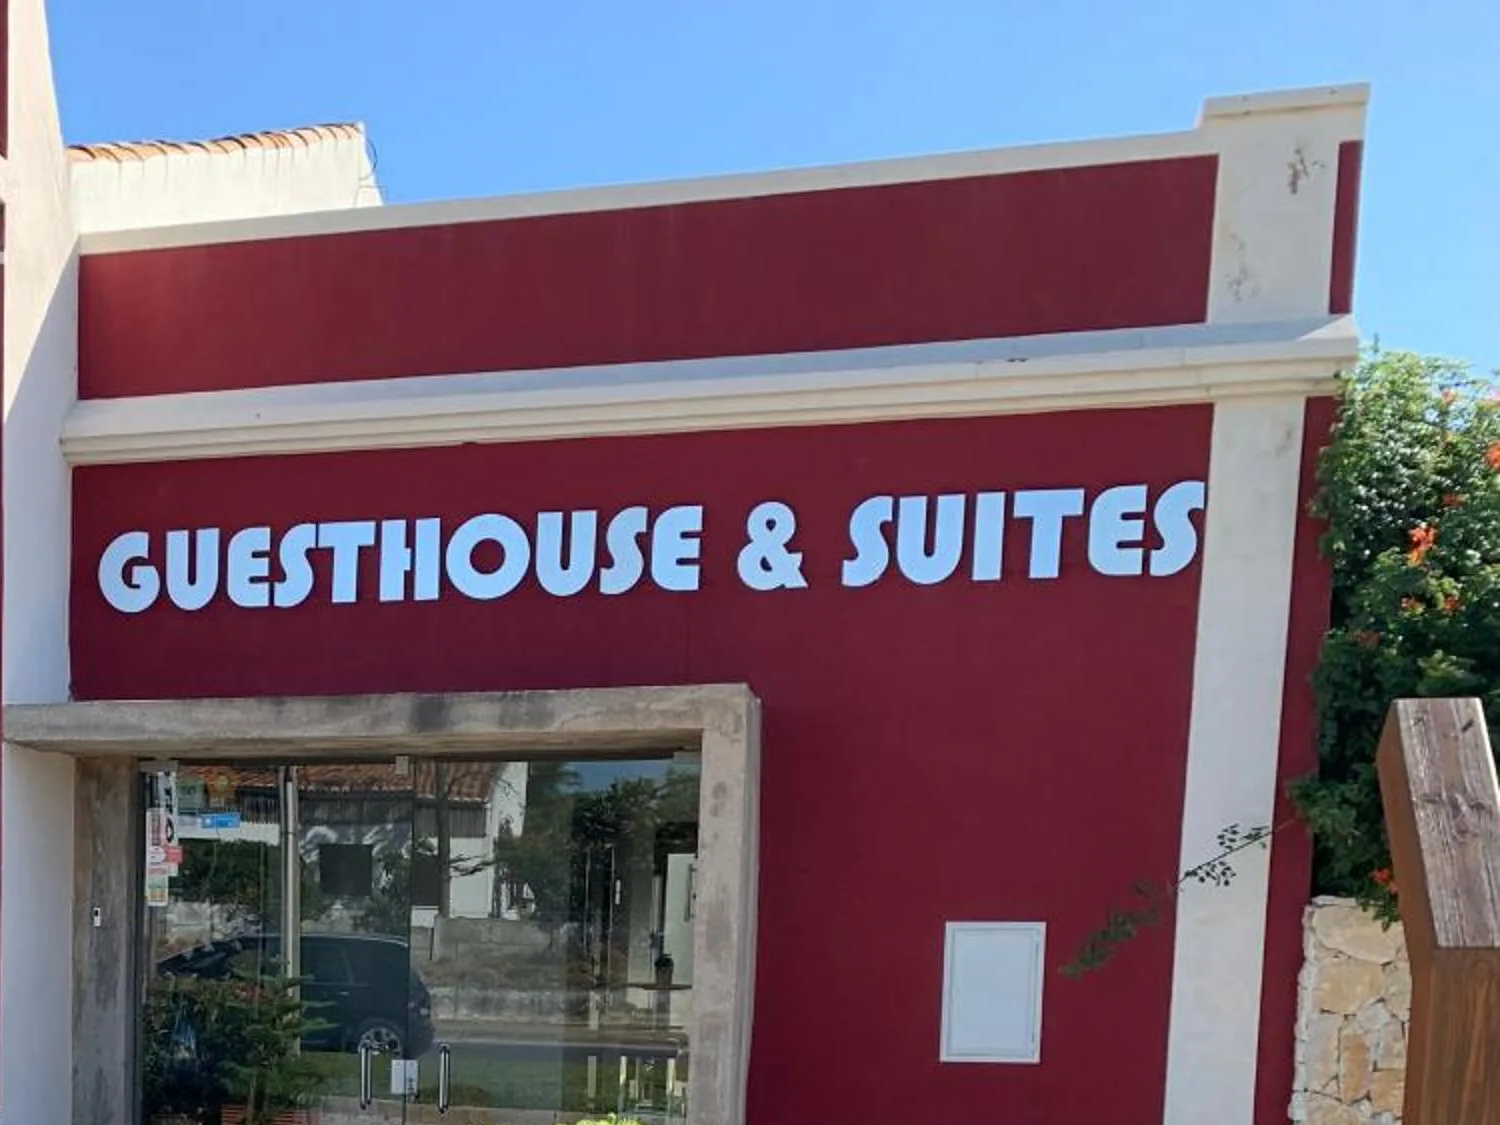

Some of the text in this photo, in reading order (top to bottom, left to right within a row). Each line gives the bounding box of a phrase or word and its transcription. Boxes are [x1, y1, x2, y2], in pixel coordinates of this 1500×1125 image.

[98, 480, 1206, 613] GUESTHOUSE & SUITES
